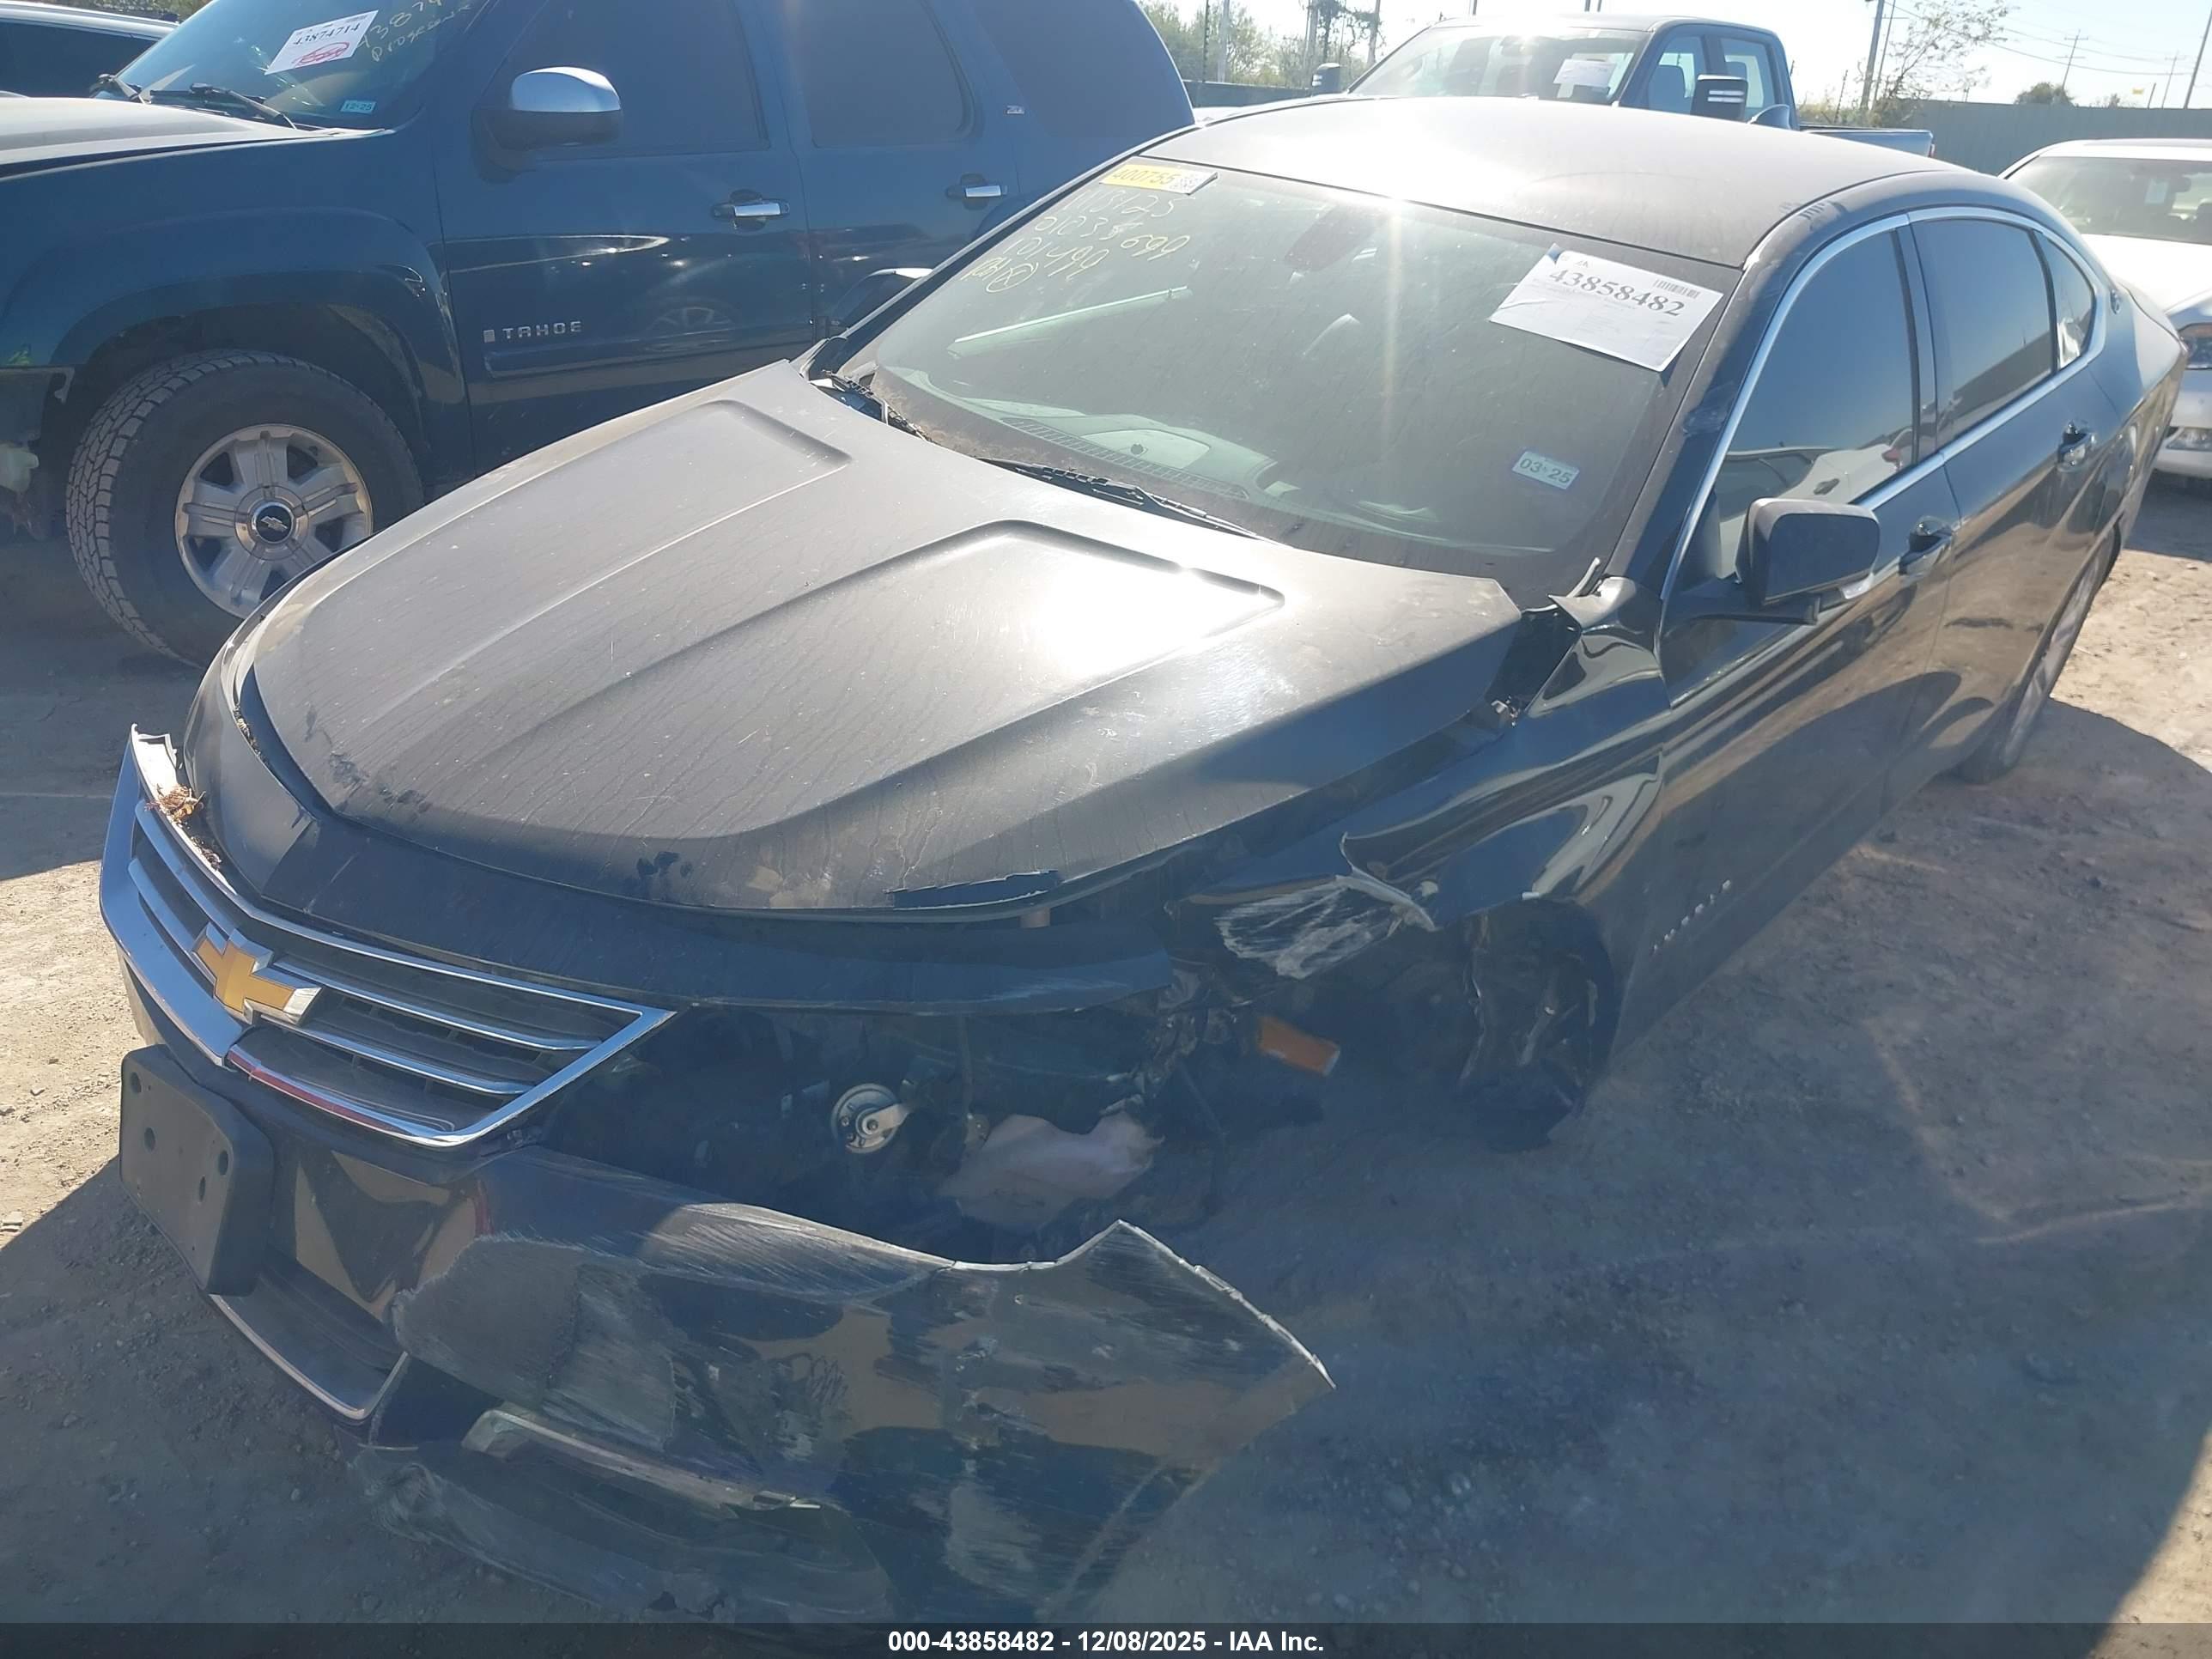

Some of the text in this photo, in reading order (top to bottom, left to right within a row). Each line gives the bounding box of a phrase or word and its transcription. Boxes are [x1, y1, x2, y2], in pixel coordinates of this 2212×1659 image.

[293, 23, 360, 45] 43874714
[1549, 269, 1685, 317] 43858482
[502, 321, 581, 339] TAHOE
